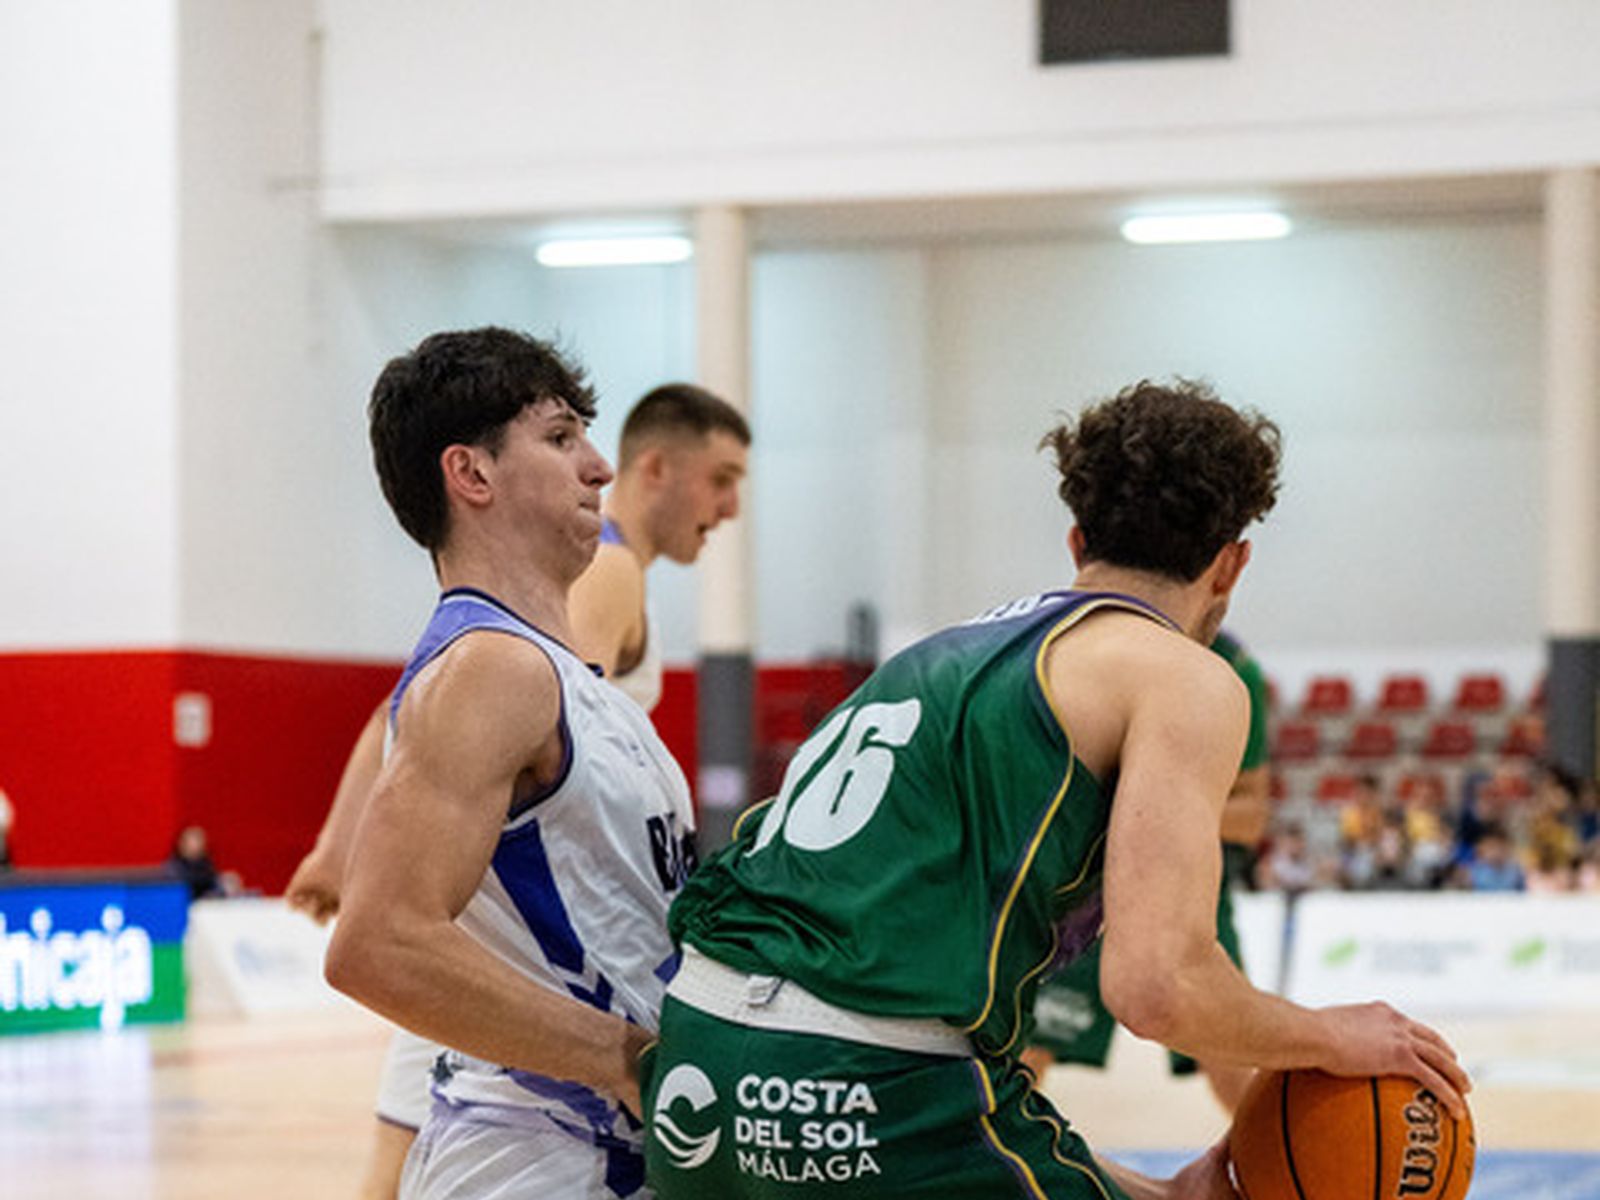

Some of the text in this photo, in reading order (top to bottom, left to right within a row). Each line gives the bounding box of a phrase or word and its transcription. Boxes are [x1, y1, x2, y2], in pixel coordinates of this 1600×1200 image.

[745, 699, 922, 858] 16
[0, 905, 153, 1031] nicaja
[737, 1075, 878, 1114] COSTA
[735, 1116, 878, 1150] DEL SOL
[737, 1150, 881, 1182] MÁLAGA
